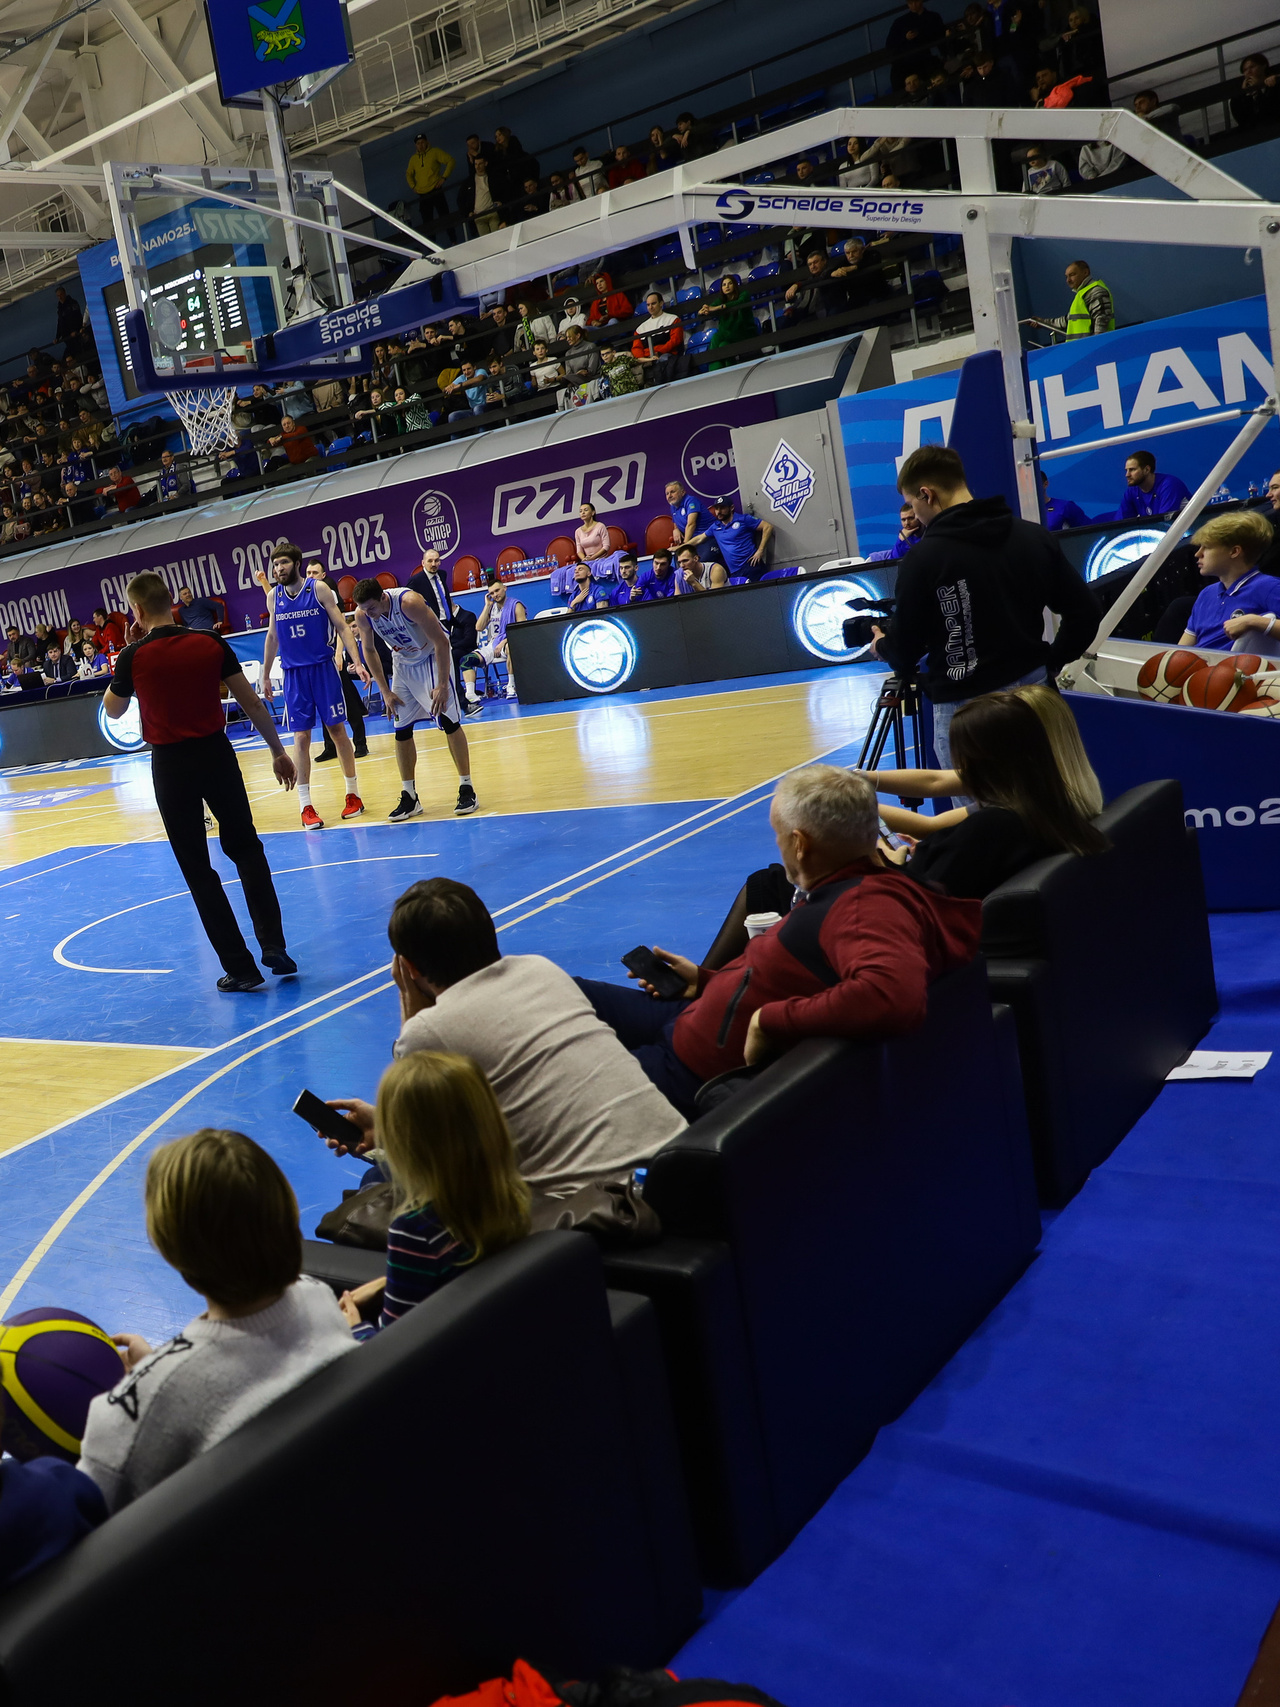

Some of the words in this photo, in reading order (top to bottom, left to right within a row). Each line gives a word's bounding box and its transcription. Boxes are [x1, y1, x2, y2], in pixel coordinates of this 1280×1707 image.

[757, 195, 844, 213] Schelde
[848, 198, 924, 217] Sports
[866, 214, 890, 224] Superior
[891, 215, 900, 224] by
[900, 216, 922, 225] Design
[187, 295, 201, 312] 64
[319, 304, 380, 332] Schelde
[321, 316, 382, 344] Sports
[497, 460, 639, 528] PARI
[781, 480, 800, 499] 100
[423, 523, 452, 543] СУПЕР
[288, 624, 307, 639] 15
[329, 702, 345, 718] 15
